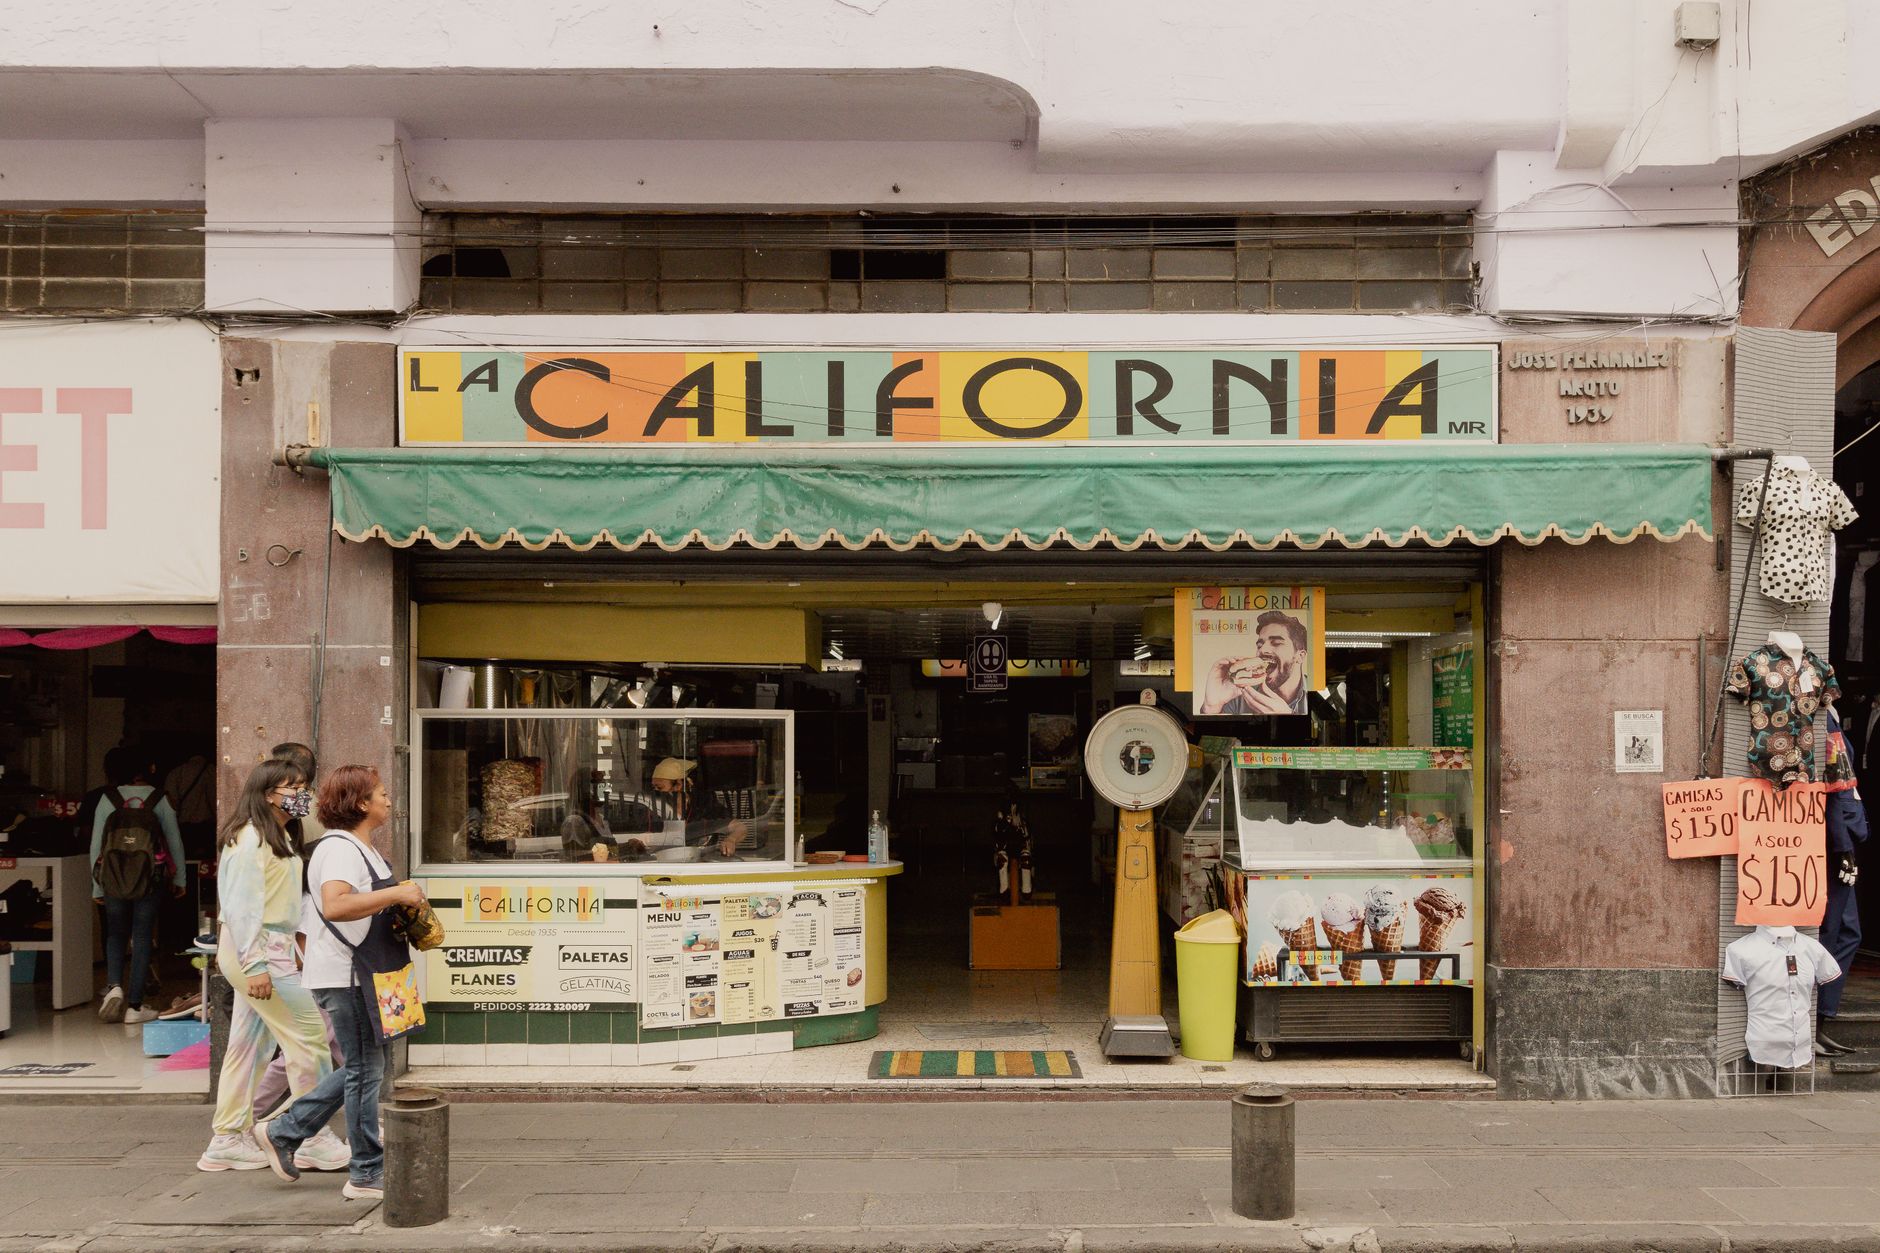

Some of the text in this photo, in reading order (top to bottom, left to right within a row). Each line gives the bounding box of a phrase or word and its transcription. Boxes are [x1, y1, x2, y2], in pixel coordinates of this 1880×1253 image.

[1803, 175, 1880, 258] ED
[1508, 349, 1671, 370] JOSE FERNANDEZ
[410, 356, 1486, 439] LA CALIFORNIA MR
[1566, 404, 1614, 425] 1939
[1201, 595, 1310, 610] CALIFORNIA
[1200, 623, 1248, 631] CALIFORNIA
[1243, 754, 1292, 763] CALIFORNIA
[1665, 787, 1723, 806] CAMISAS
[1690, 805, 1712, 813] SOLO
[1742, 789, 1826, 825] CAMISAS
[1755, 834, 1803, 848] A SOLO
[467, 893, 600, 913] LA CALIFORNIA
[647, 912, 682, 923] MENU
[507, 928, 557, 937] Desde 1935
[447, 948, 522, 963] CREMITAS
[562, 952, 629, 963] PALETAS
[451, 973, 516, 986] FLANES
[560, 978, 631, 994] GELATINAS
[473, 1002, 591, 1012] PEDIDOS: 2222 320097
